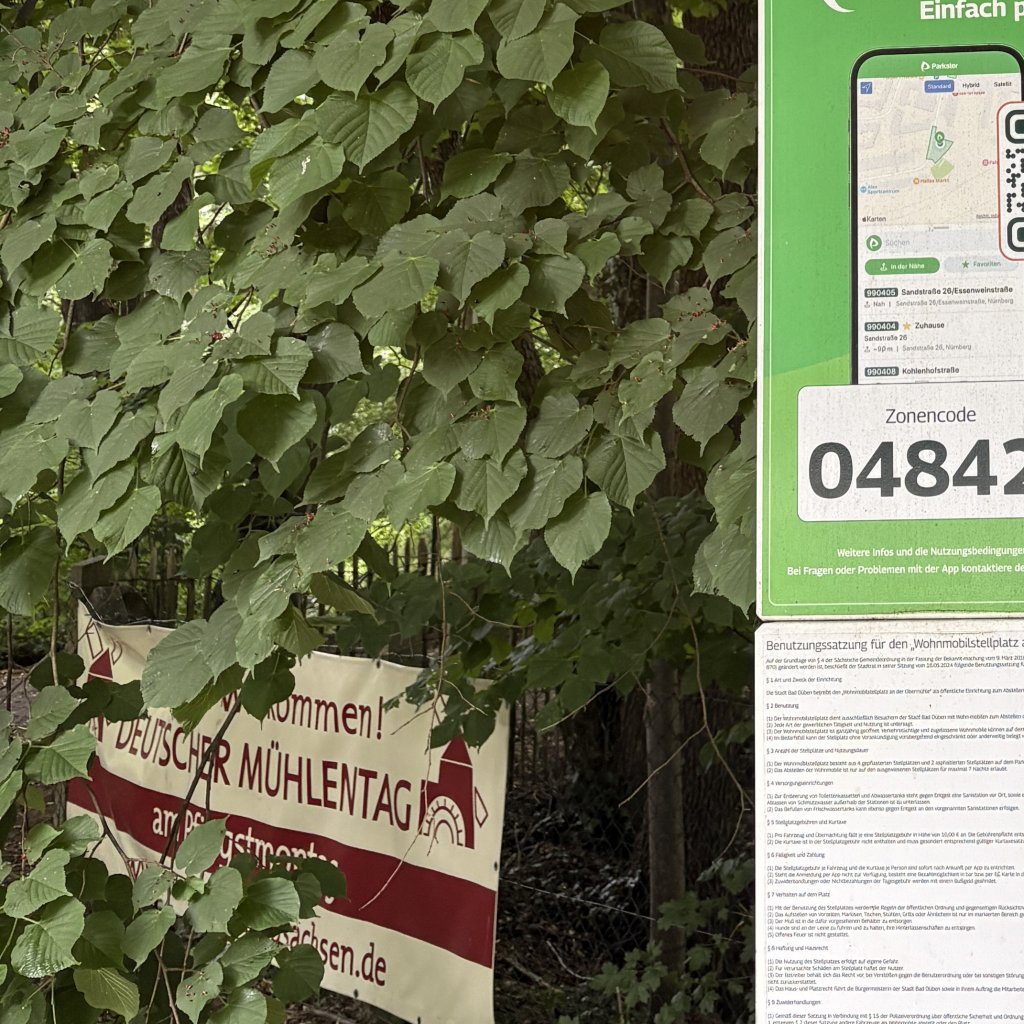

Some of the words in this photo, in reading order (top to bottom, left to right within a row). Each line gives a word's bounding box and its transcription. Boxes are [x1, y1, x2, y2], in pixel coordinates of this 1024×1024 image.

[962, 81, 980, 89] Hybrid
[886, 406, 977, 425] Zonencode
[837, 548, 870, 557] Weitere
[873, 548, 894, 557] Infos
[896, 547, 913, 556] und
[915, 547, 928, 556] die
[787, 566, 801, 575] Bei
[803, 566, 833, 576] Fragen
[835, 566, 856, 575] oder
[858, 565, 905, 575] Problemen
[908, 564, 922, 573] mit
[925, 564, 940, 573] der
[942, 564, 959, 575] App
[961, 563, 1012, 573] kontaktiere
[766, 640, 868, 652] Benutzungssatzung
[870, 639, 886, 649] für
[888, 638, 908, 649] den
[910, 637, 1019, 652] „Wohnmobilstellplatz
[115, 716, 231, 786] DEUTSCHER
[238, 740, 412, 831] MÜHLENTAG
